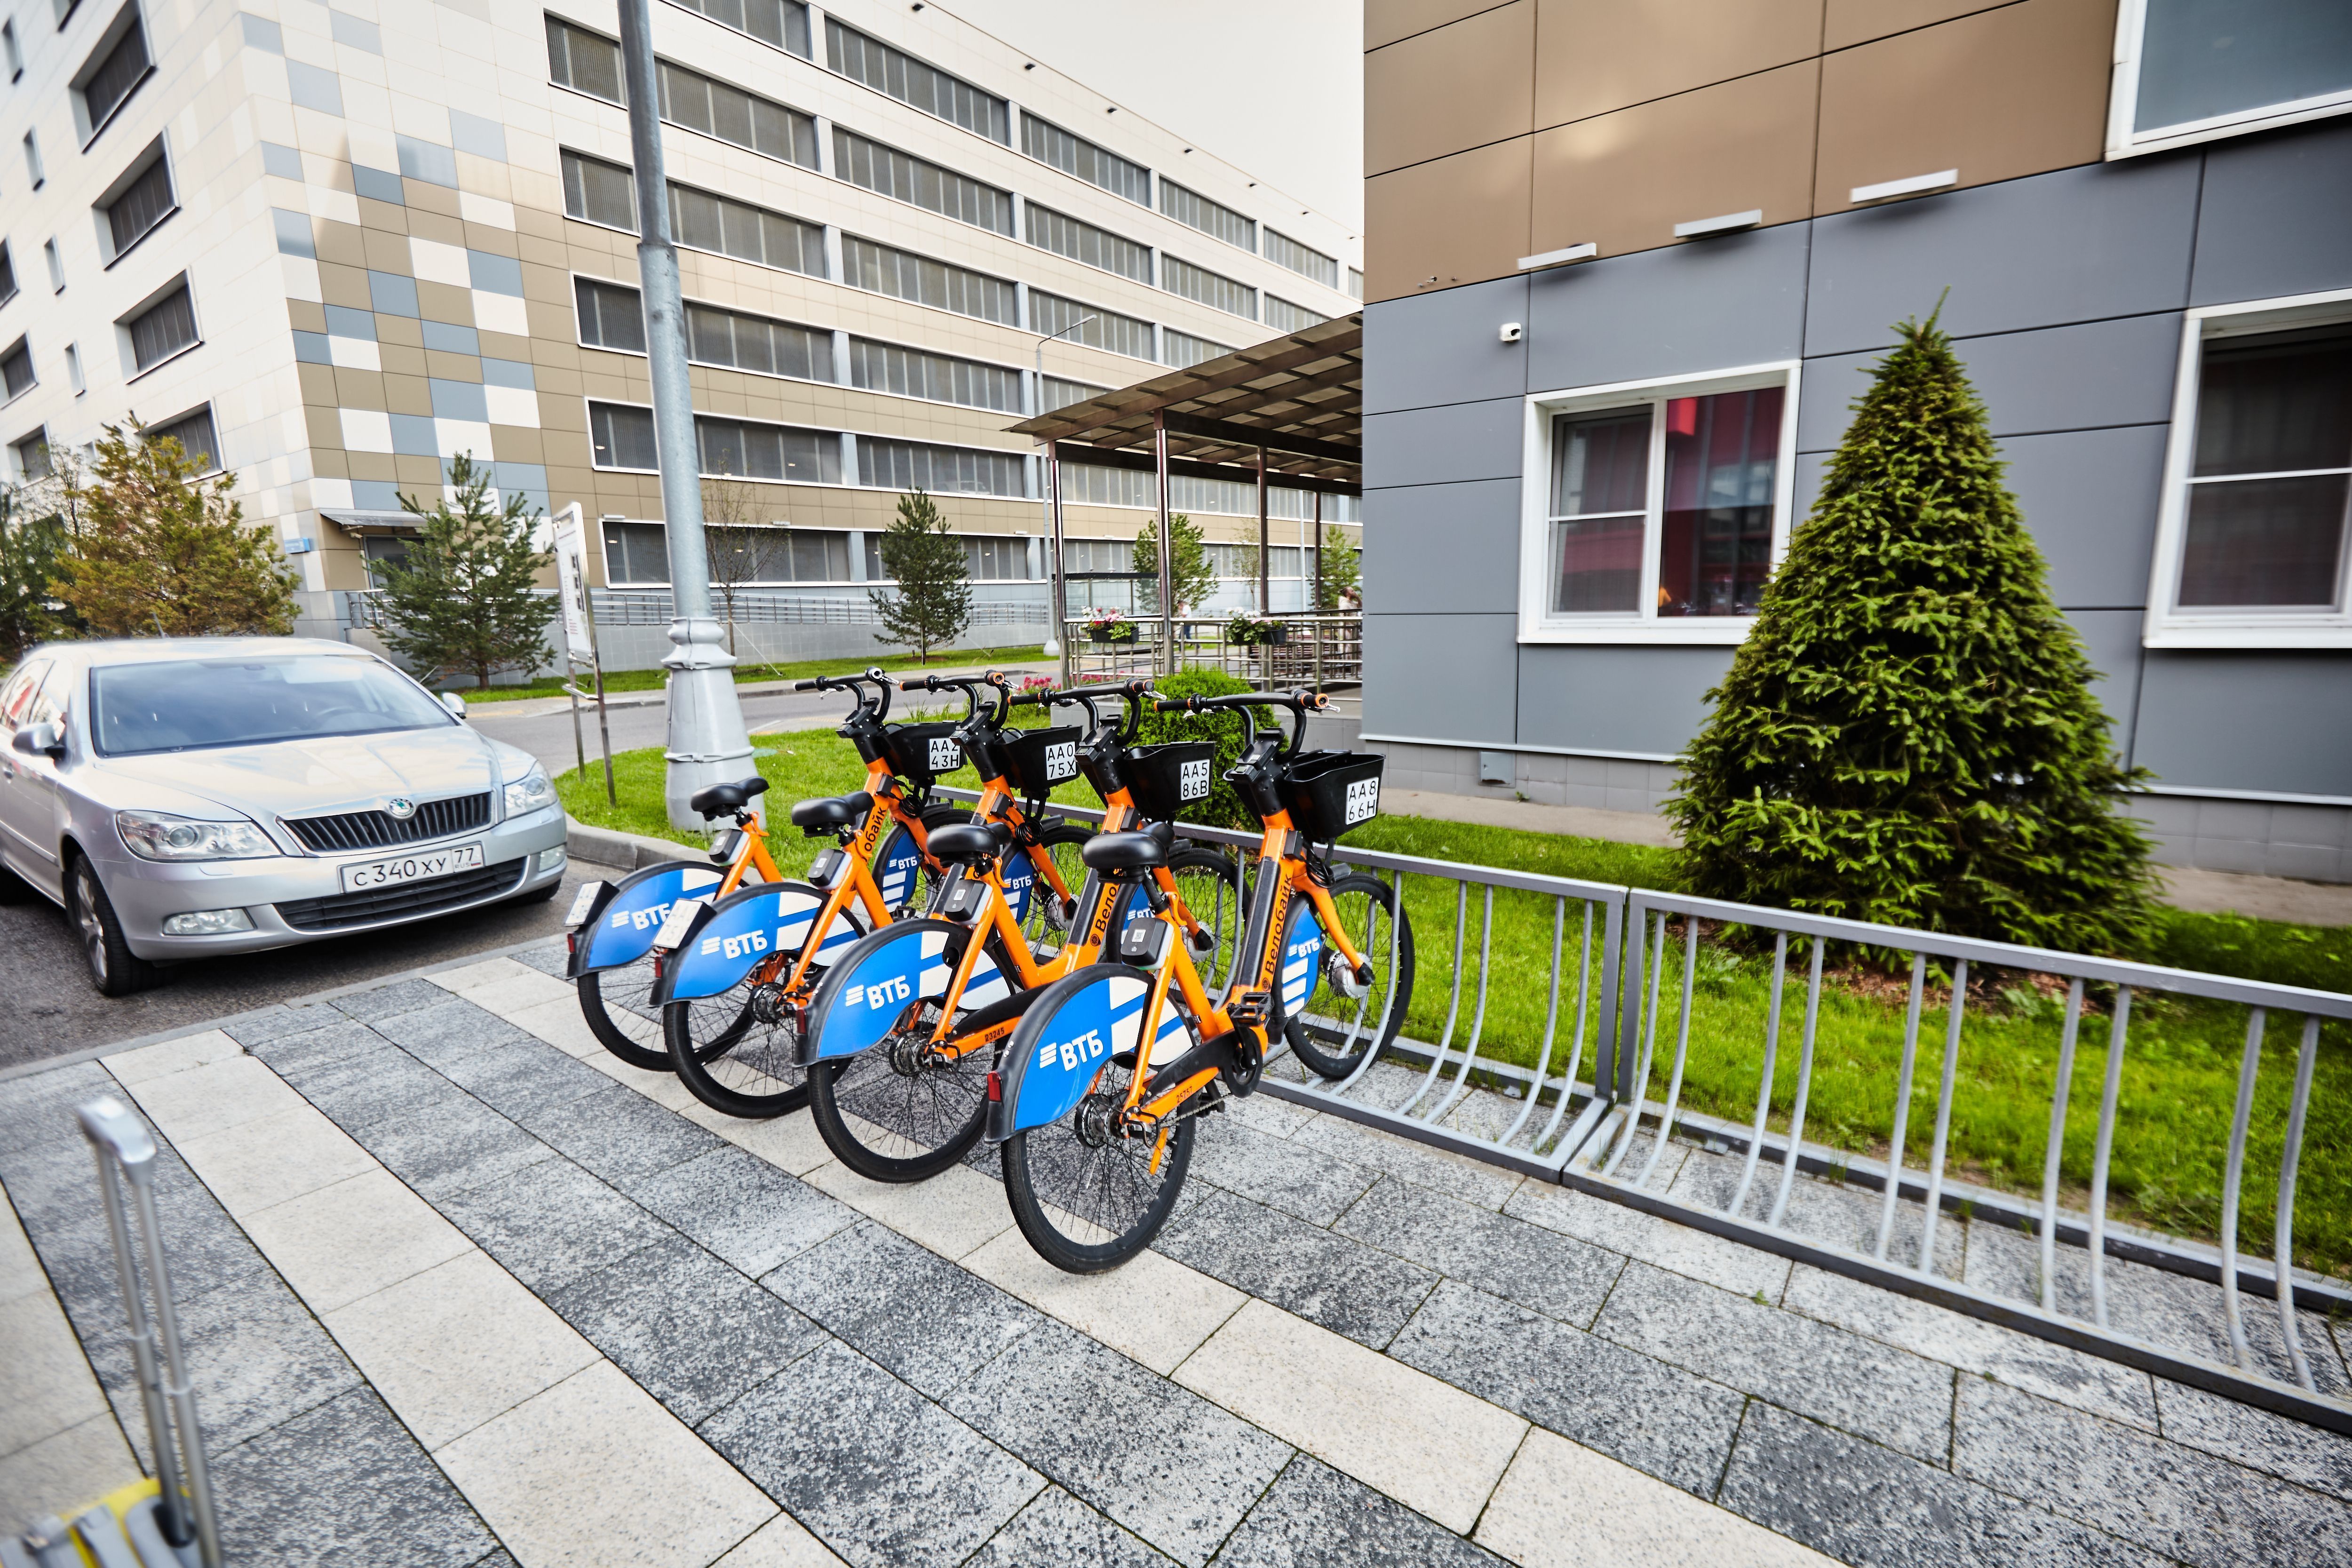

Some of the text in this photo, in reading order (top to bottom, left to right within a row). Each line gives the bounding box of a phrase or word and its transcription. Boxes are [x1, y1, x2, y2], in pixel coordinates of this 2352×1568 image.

[864, 806, 886, 852] обайк
[454, 848, 474, 863] 77
[898, 856, 918, 870] ВТБ
[1013, 875, 1032, 890] ВТБ
[1095, 886, 1117, 933] Вело
[1265, 874, 1292, 975] Велобайк
[723, 929, 768, 960] ВТБ
[1297, 937, 1320, 958] ВТБ
[866, 975, 911, 1011] ВТБ
[1059, 1028, 1104, 1072] ВТБ
[1176, 1086, 1192, 1103] 25757
